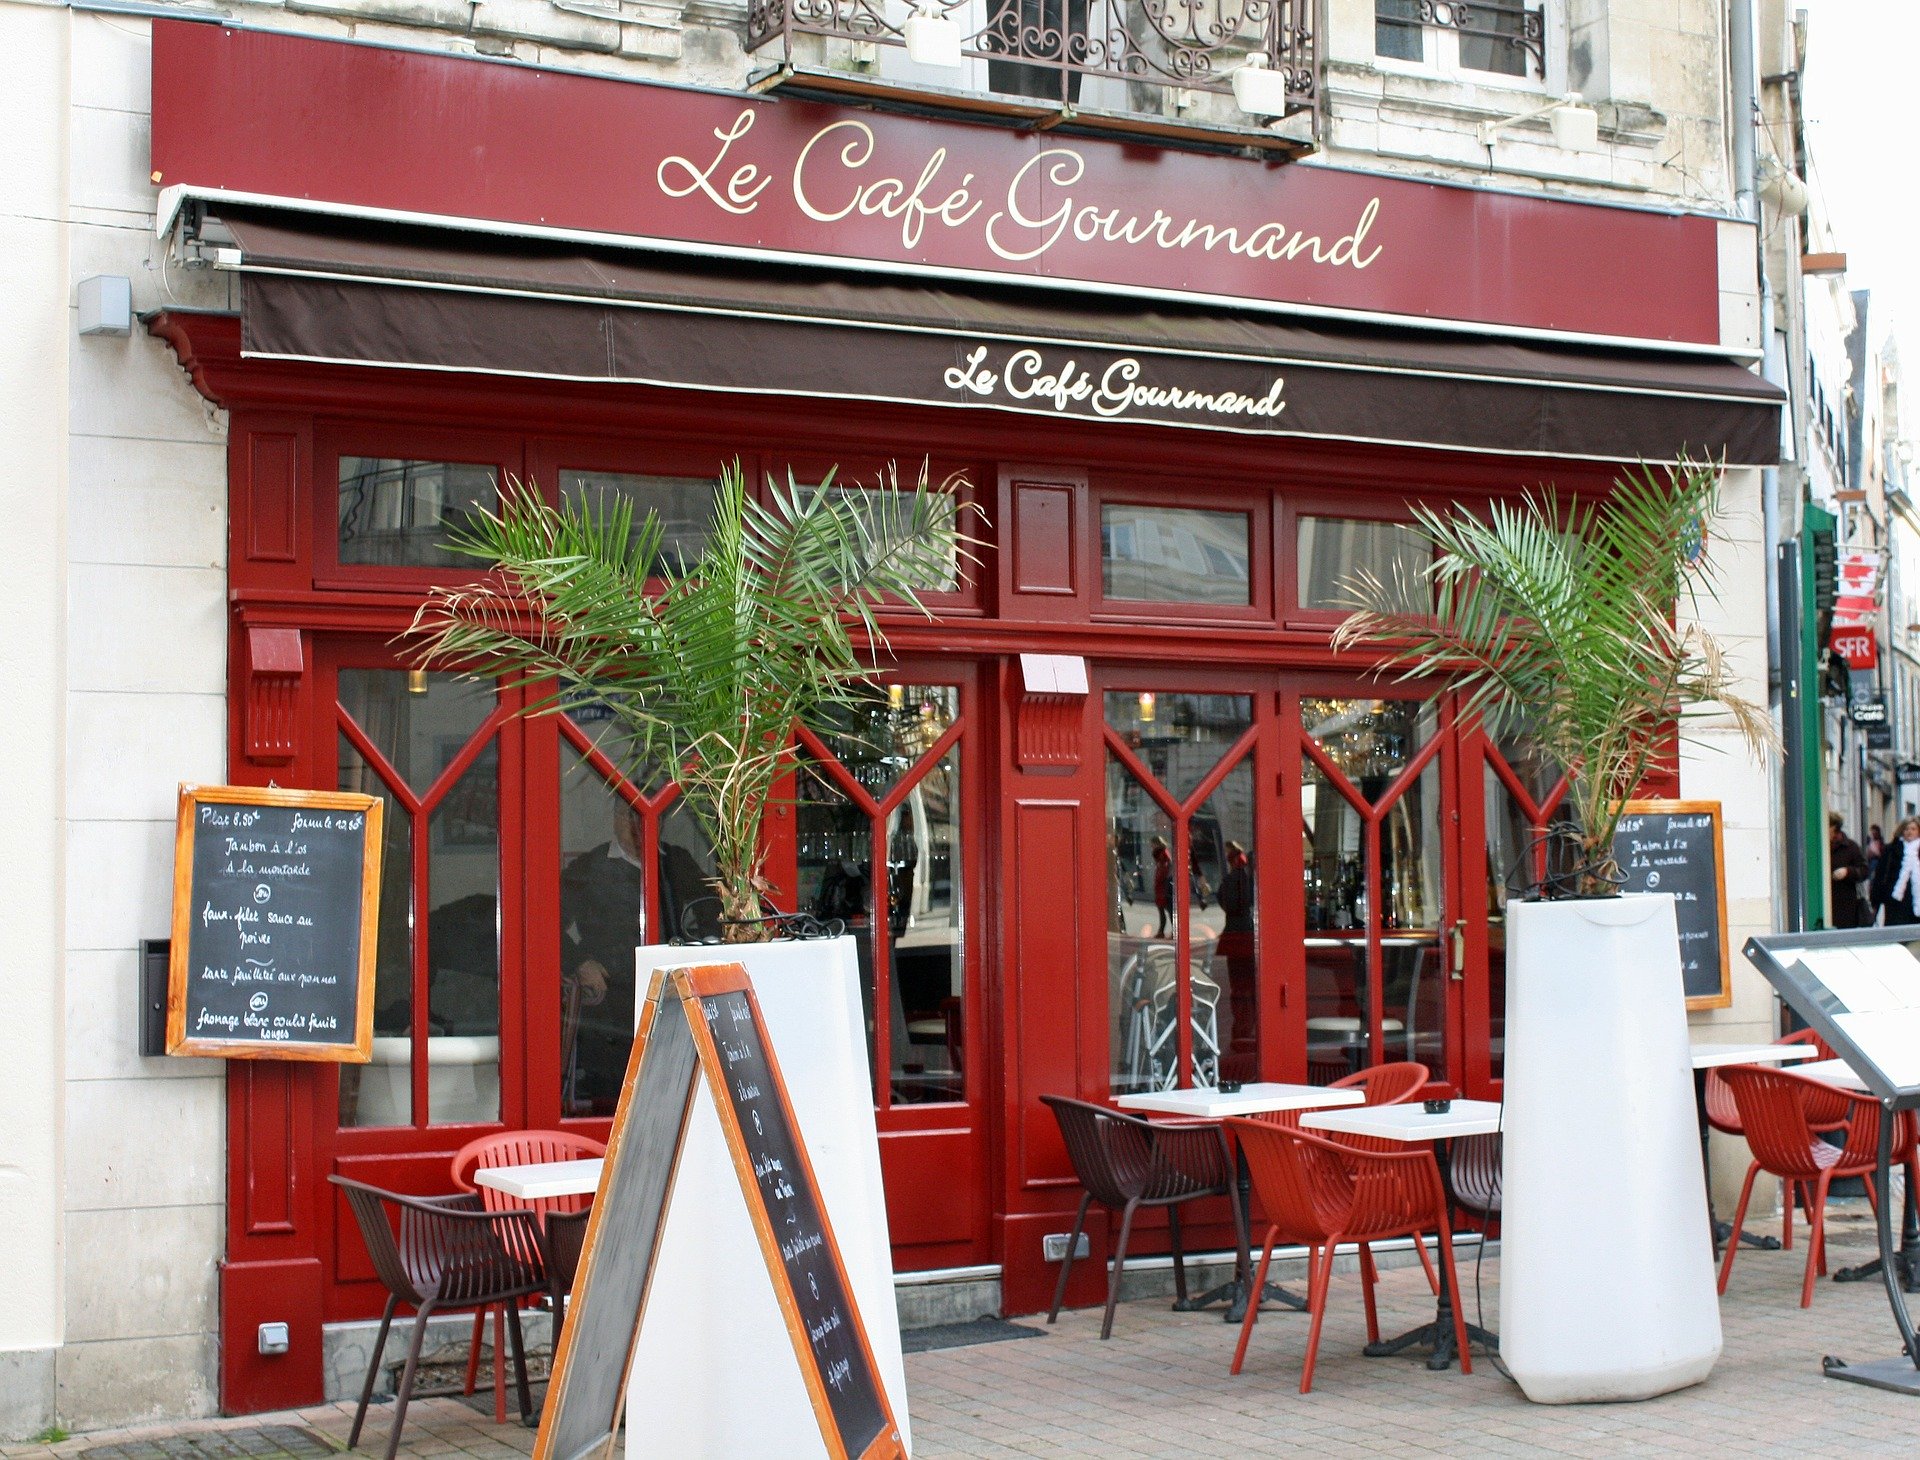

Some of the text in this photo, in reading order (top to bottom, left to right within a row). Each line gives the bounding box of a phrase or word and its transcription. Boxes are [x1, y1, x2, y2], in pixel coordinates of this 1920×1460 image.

[657, 108, 1383, 269] Le Café Gourmand
[944, 346, 1285, 416] Le Café Gourmand
[1834, 636, 1870, 657] SFR
[201, 807, 229, 827] Plat
[238, 860, 254, 874] la
